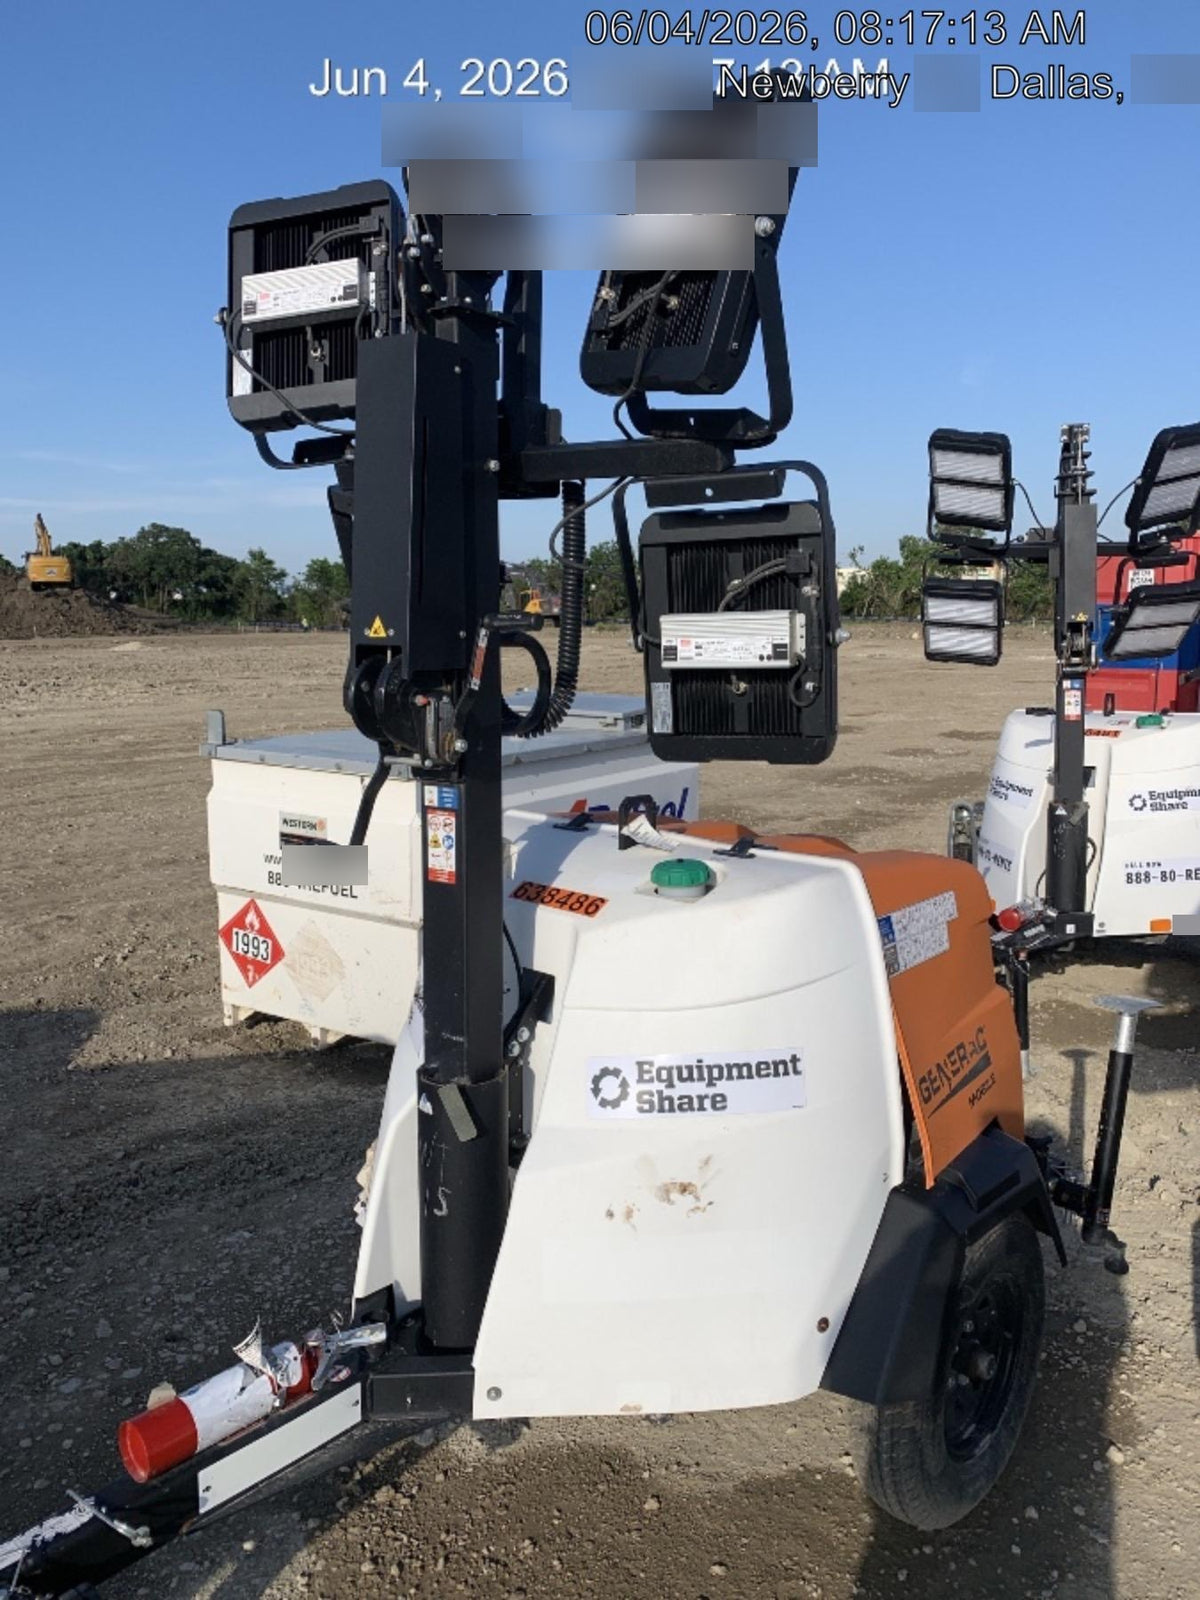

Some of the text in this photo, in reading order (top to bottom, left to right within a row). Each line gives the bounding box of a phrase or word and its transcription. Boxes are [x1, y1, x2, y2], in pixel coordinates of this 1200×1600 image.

[1148, 789, 1200, 802] Equipm
[513, 882, 606, 916] 638486
[234, 931, 269, 961] 1993
[635, 1053, 803, 1089] Equipment
[635, 1090, 728, 1114] Share
